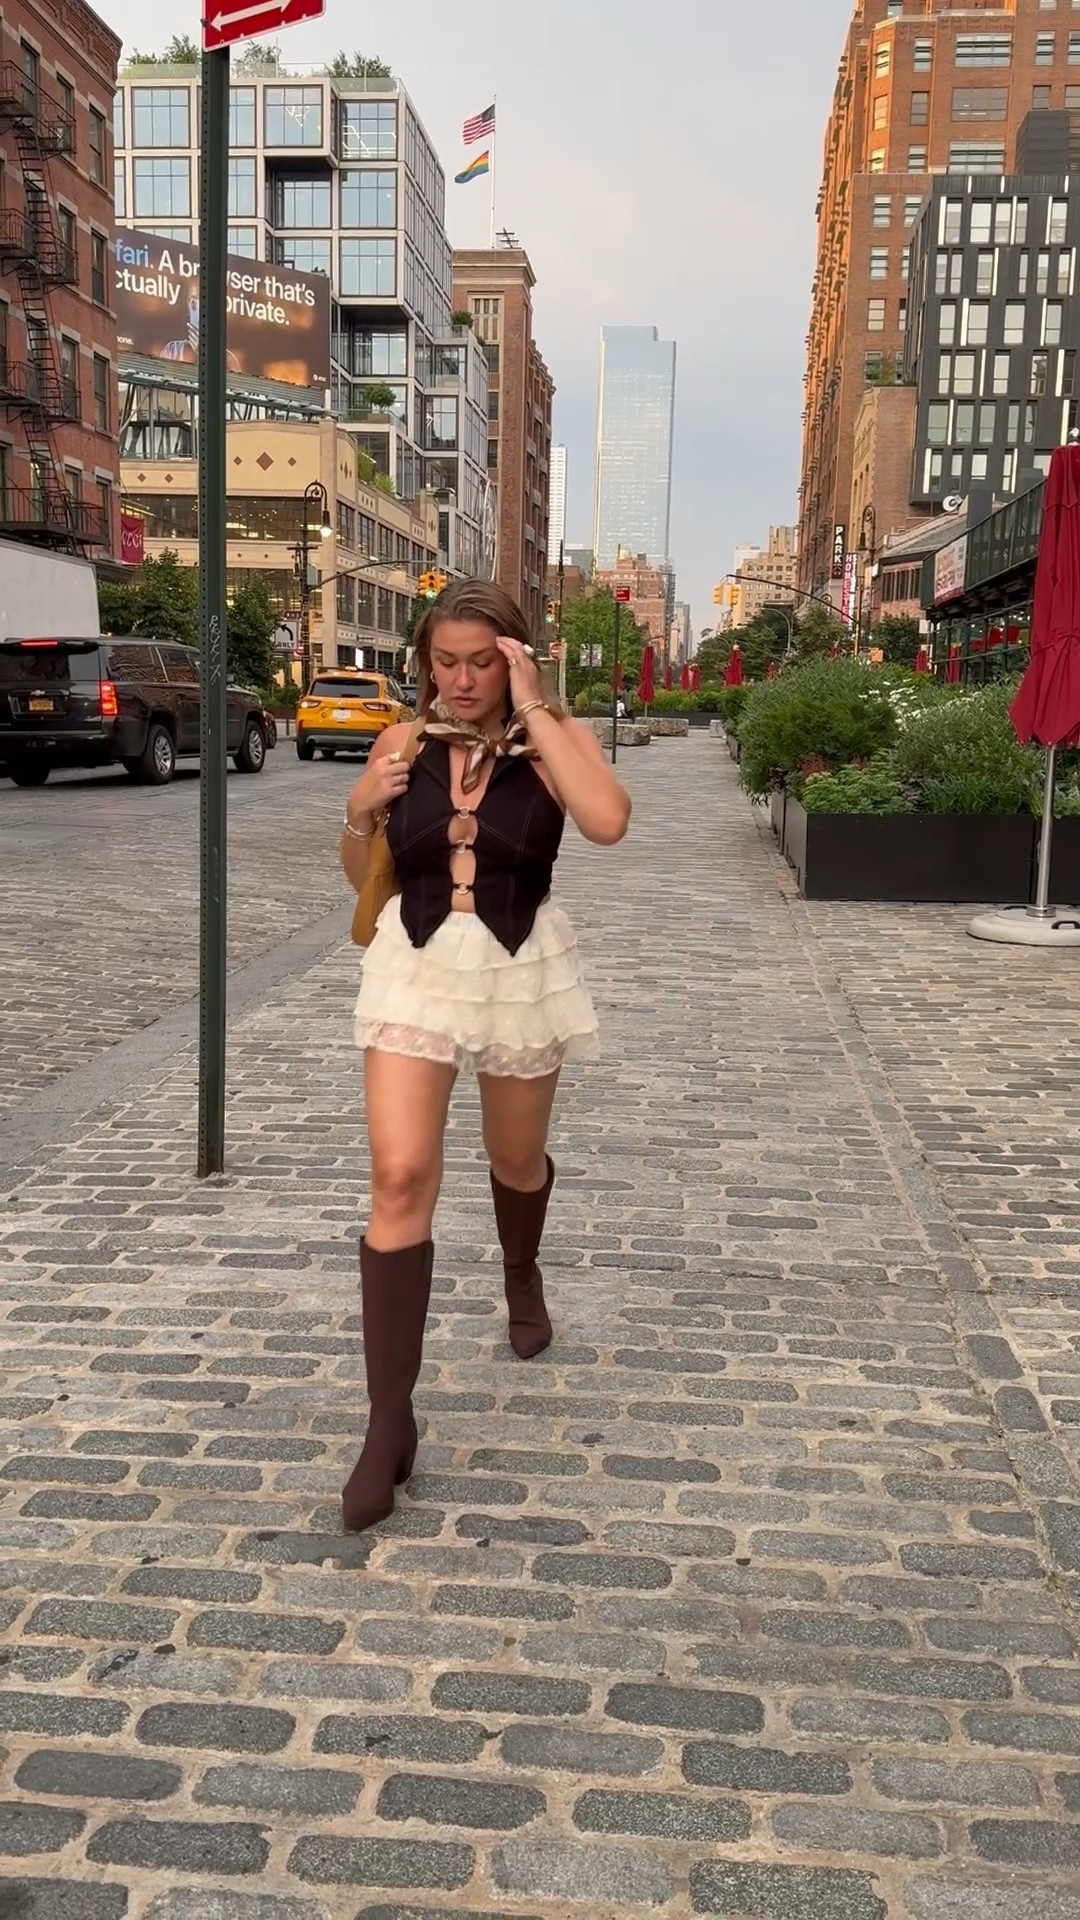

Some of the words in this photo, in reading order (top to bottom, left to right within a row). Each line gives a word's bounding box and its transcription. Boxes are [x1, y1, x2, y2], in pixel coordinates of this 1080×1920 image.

[114, 238, 154, 269] fari.
[158, 249, 175, 275] A
[264, 275, 316, 307] that's
[834, 526, 844, 564] PARK
